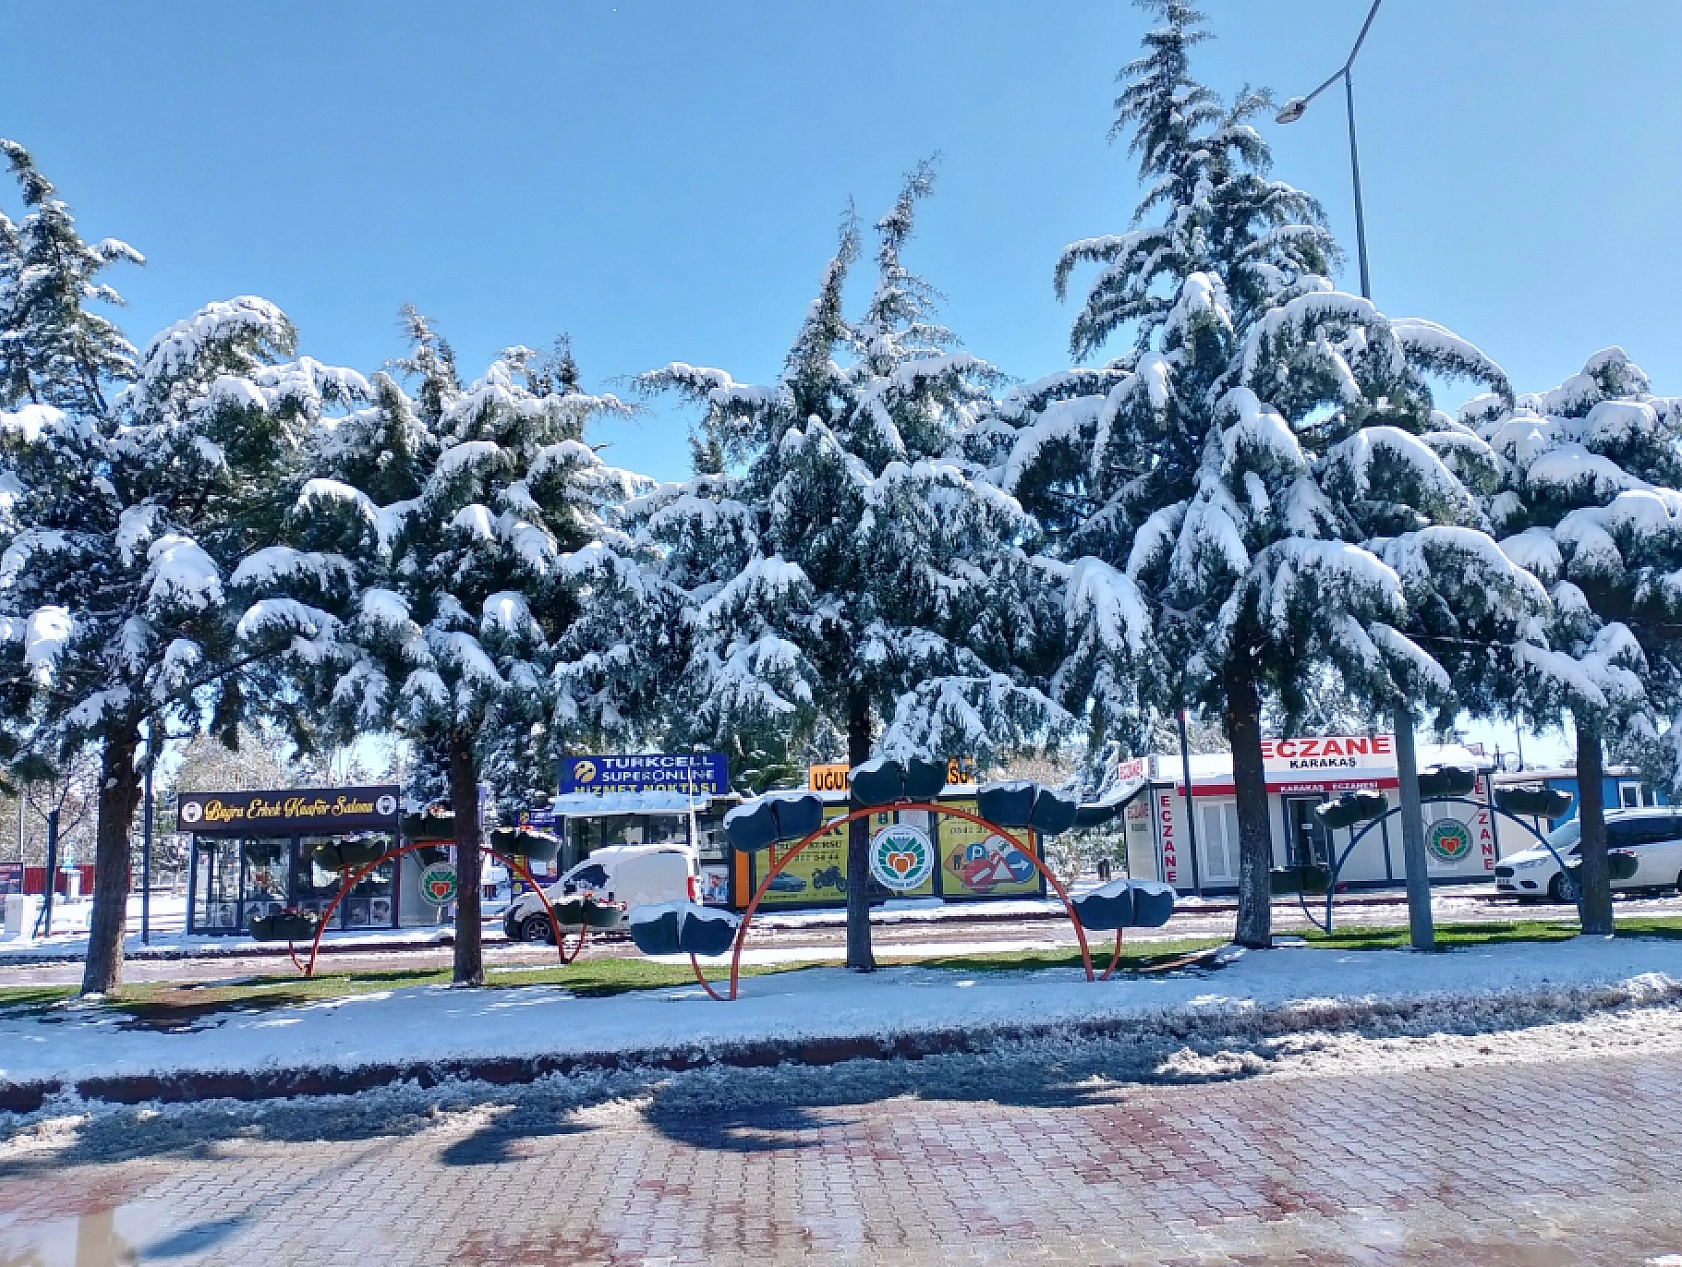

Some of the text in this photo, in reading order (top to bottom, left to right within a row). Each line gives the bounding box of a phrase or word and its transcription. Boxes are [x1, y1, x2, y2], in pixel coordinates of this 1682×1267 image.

[1260, 736, 1391, 759] ECZANE
[602, 756, 715, 769] TURKCELL
[602, 769, 715, 782] SUPERONLINE
[1160, 795, 1177, 883] ECZANE
